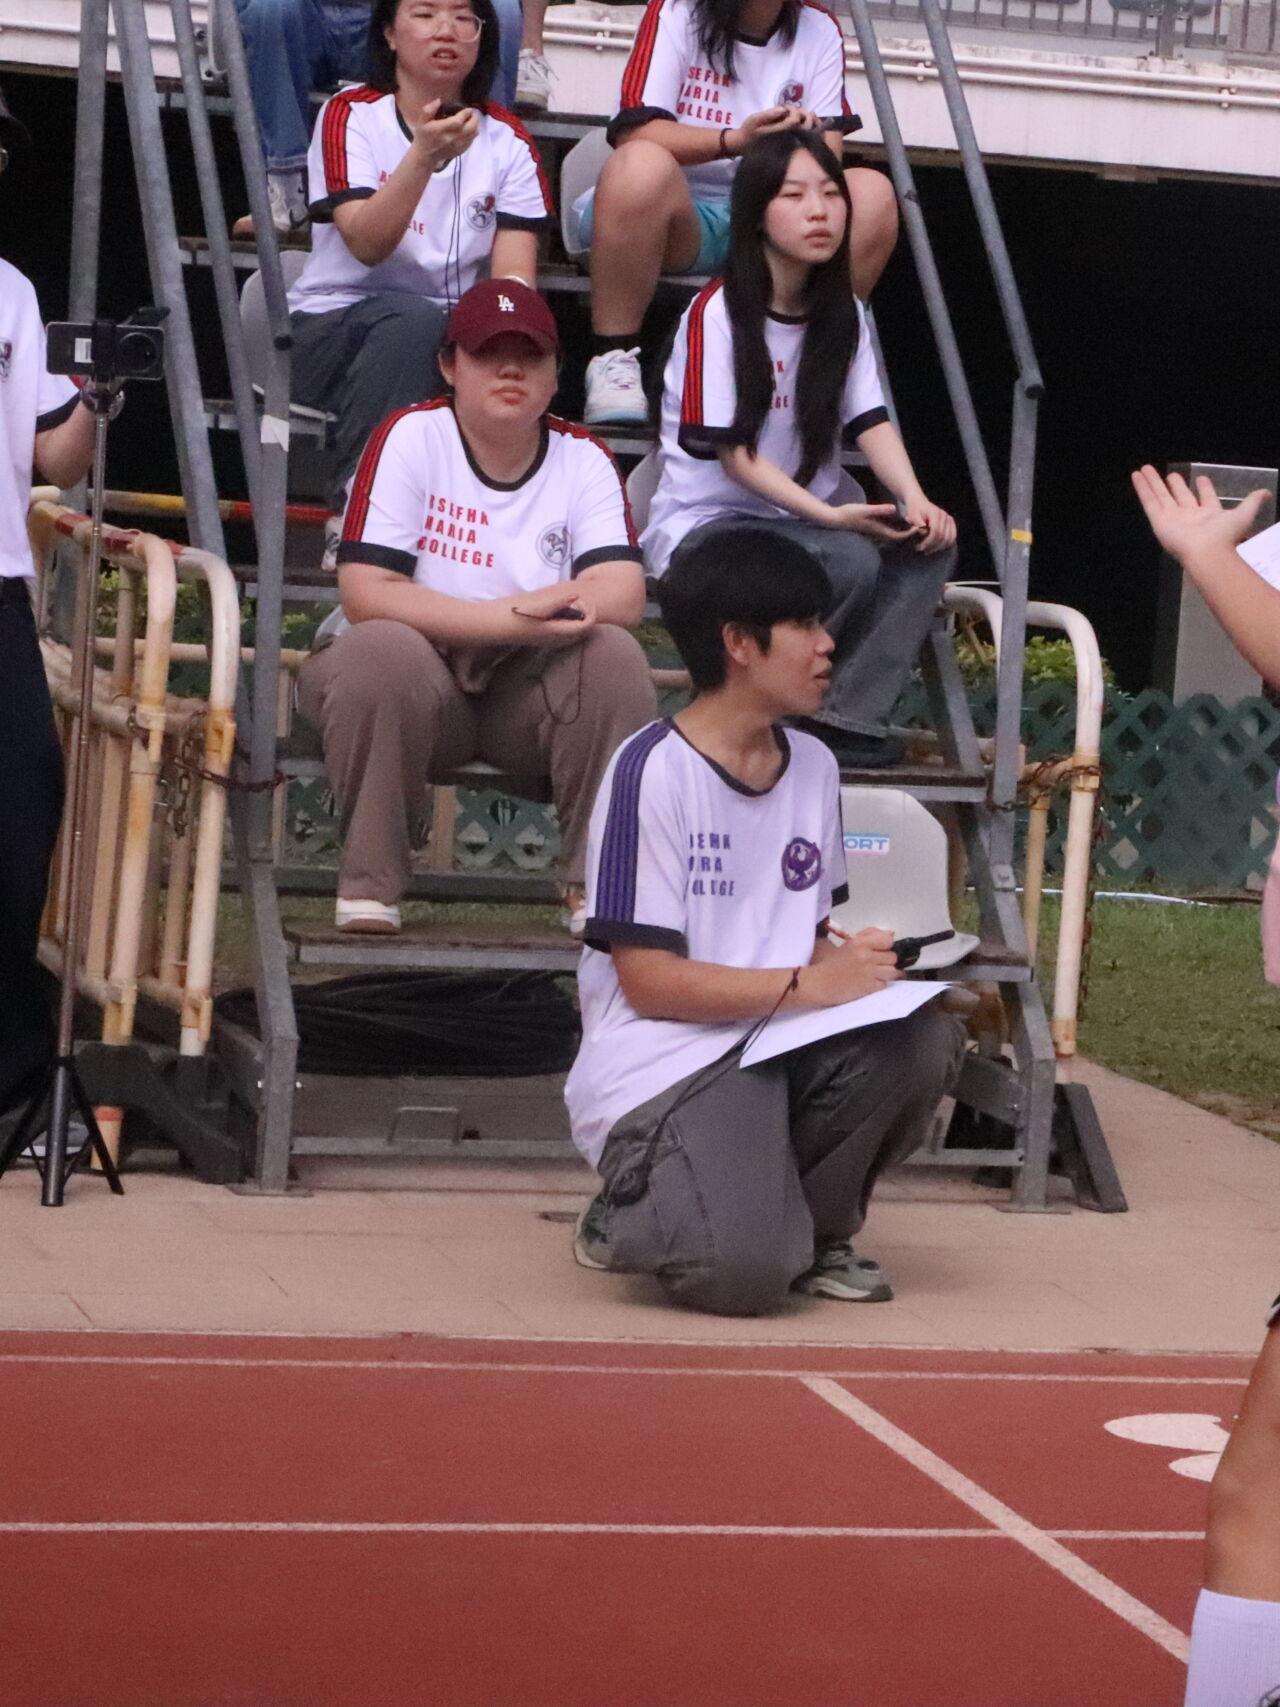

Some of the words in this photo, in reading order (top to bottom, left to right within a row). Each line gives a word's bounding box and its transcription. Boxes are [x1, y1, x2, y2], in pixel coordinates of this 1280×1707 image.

[687, 66, 730, 87] SEFHK
[680, 83, 719, 104] ARIA
[676, 102, 733, 125] OLLEGE
[497, 294, 515, 311] LA
[844, 838, 888, 850] ORT
